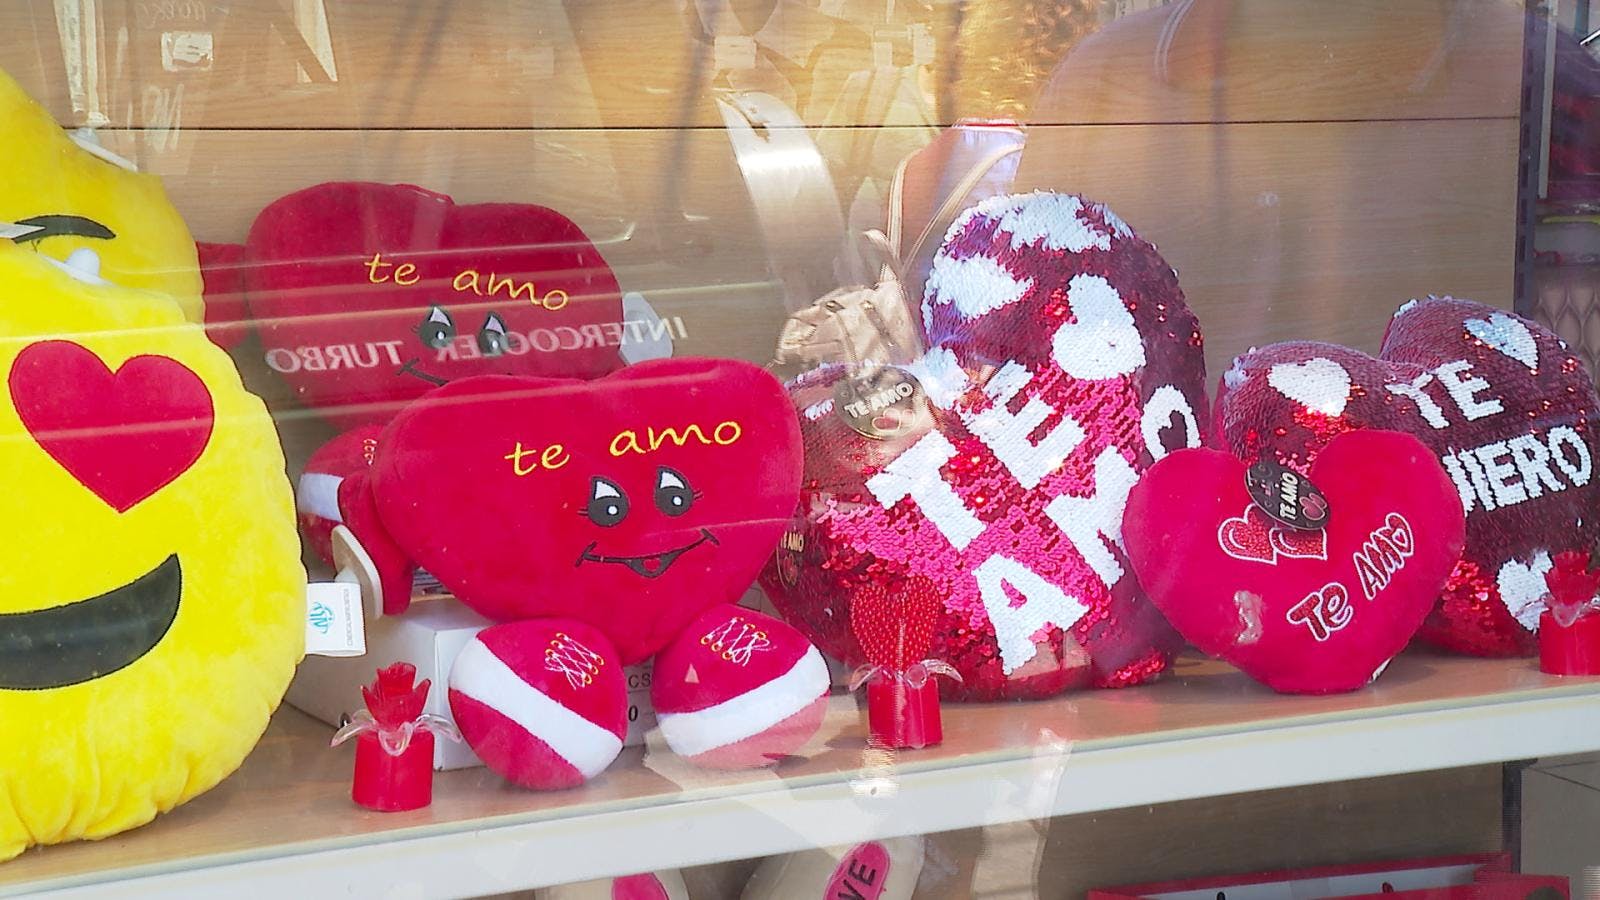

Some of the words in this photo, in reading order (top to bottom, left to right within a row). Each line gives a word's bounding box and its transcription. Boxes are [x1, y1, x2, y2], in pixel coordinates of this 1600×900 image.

[364, 253, 420, 286] te
[453, 268, 569, 312] amo
[843, 399, 870, 418] TE
[870, 382, 914, 412] AMO
[504, 441, 571, 477] te
[609, 420, 742, 458] amo
[864, 359, 1086, 552] TE
[1279, 472, 1299, 505] AMO
[1279, 502, 1297, 521] TE
